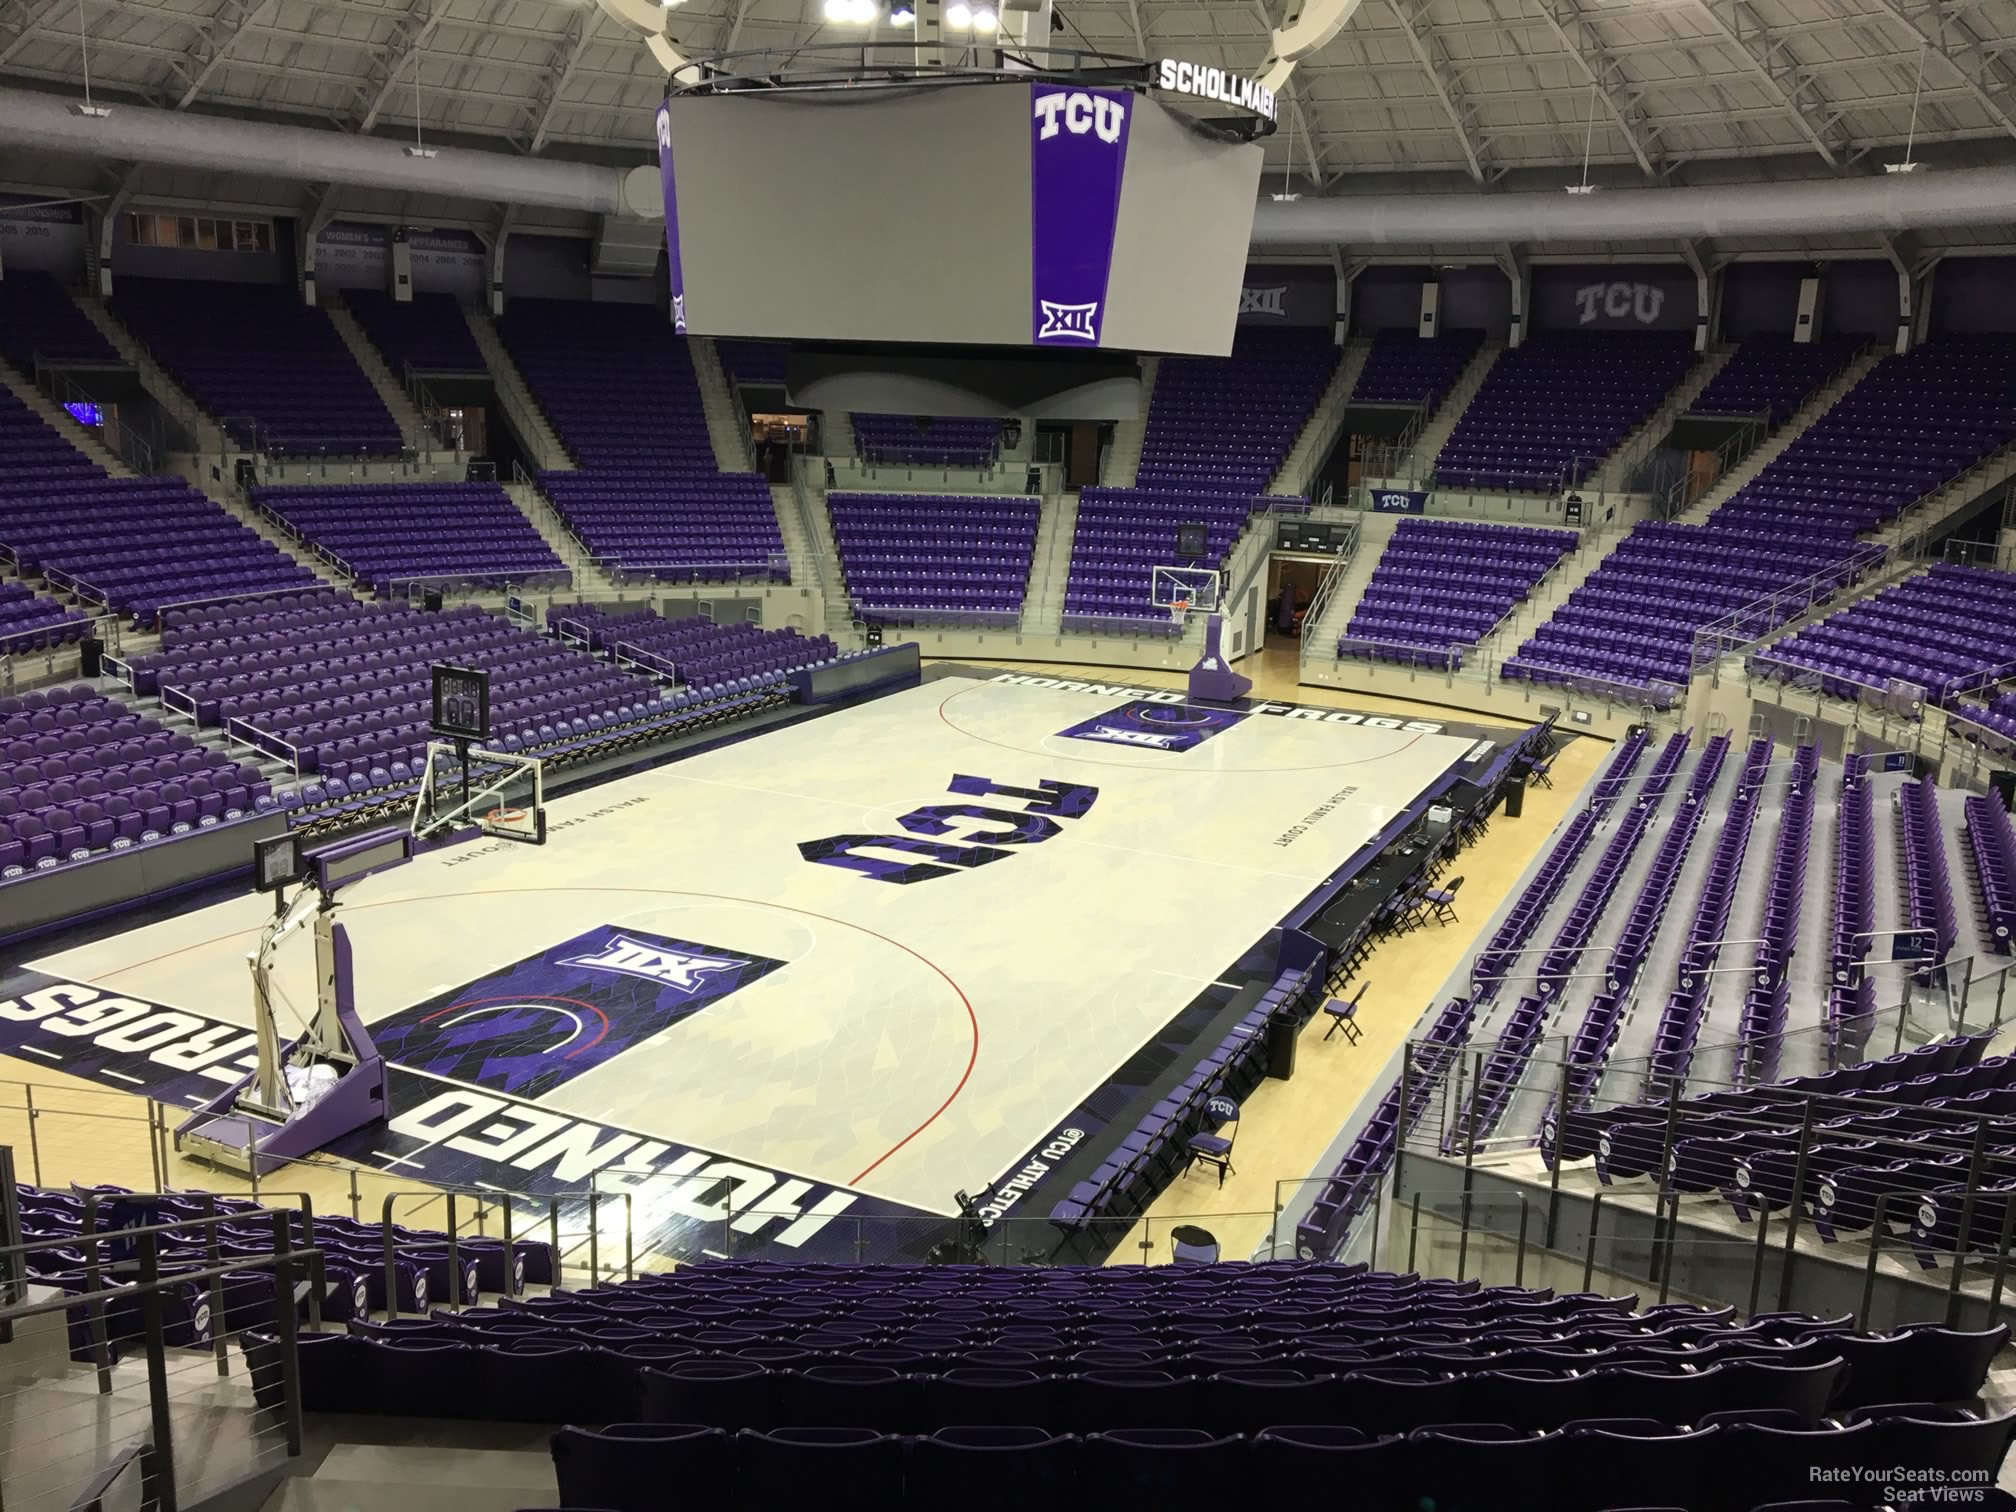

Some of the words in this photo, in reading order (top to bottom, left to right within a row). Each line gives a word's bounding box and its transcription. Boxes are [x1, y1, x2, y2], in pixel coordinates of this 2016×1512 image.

[1160, 58, 1274, 121] SCHOLLMAIER
[1034, 92, 1125, 144] TCU
[1575, 281, 1665, 325] TCU
[1382, 494, 1410, 509] TCU
[991, 673, 1187, 704] HORNED
[1249, 703, 1442, 735] FROGS
[1326, 785, 1360, 804] WALSH
[587, 796, 650, 818] WALSH
[143, 831, 160, 842] TCU
[173, 823, 190, 833] TCU
[796, 773, 1099, 885] TCU
[1272, 825, 1308, 847] COURT
[112, 838, 132, 849] TCU
[38, 858, 57, 869] TCU
[71, 850, 90, 860] TCU
[4, 868, 23, 878] TCU
[1910, 935, 1923, 948] 12
[1210, 1100, 1233, 1117] TCU
[388, 1090, 858, 1249] HORNED
[1920, 1209, 1935, 1223] TCU
